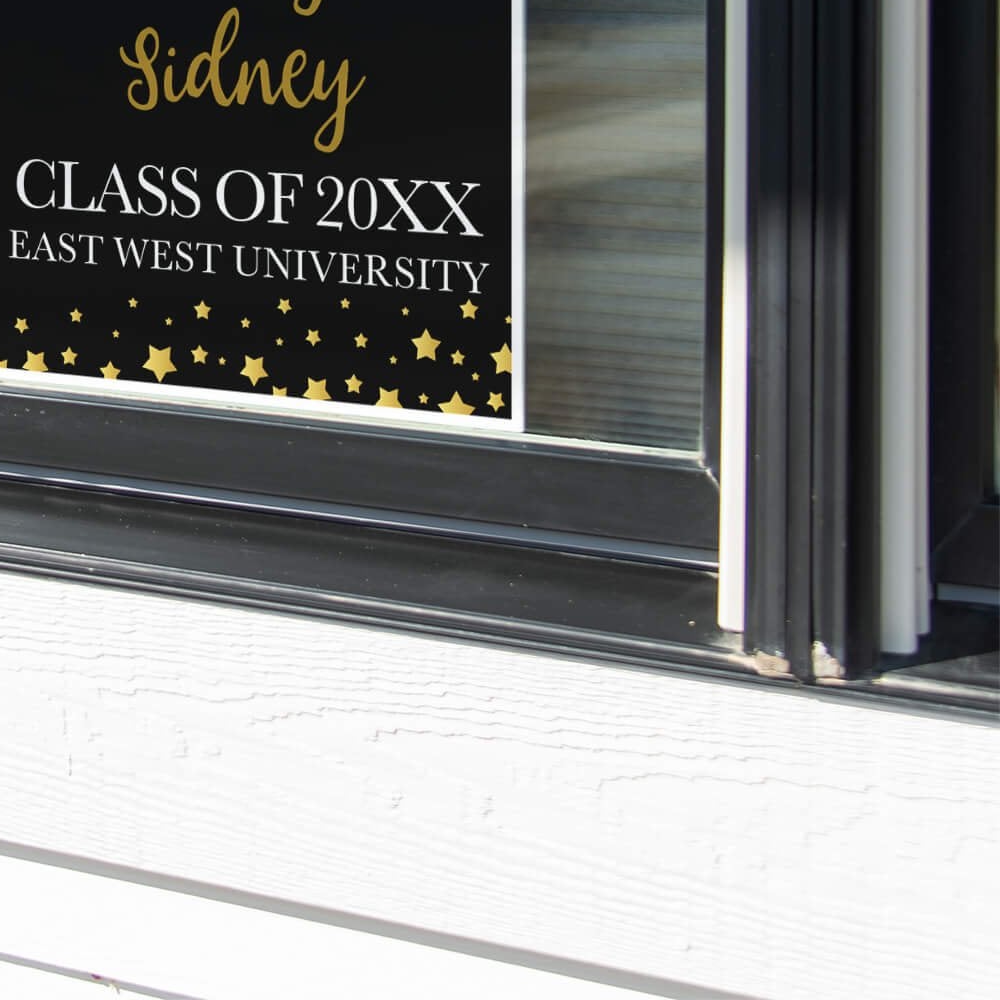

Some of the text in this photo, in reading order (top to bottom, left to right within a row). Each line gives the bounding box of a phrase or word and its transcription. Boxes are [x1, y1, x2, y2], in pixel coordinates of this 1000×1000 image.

[119, 7, 367, 153] Sidney
[16, 158, 484, 238] CLASS OF 20XX
[8, 229, 490, 295] EAST WEST UNIVERSITY
